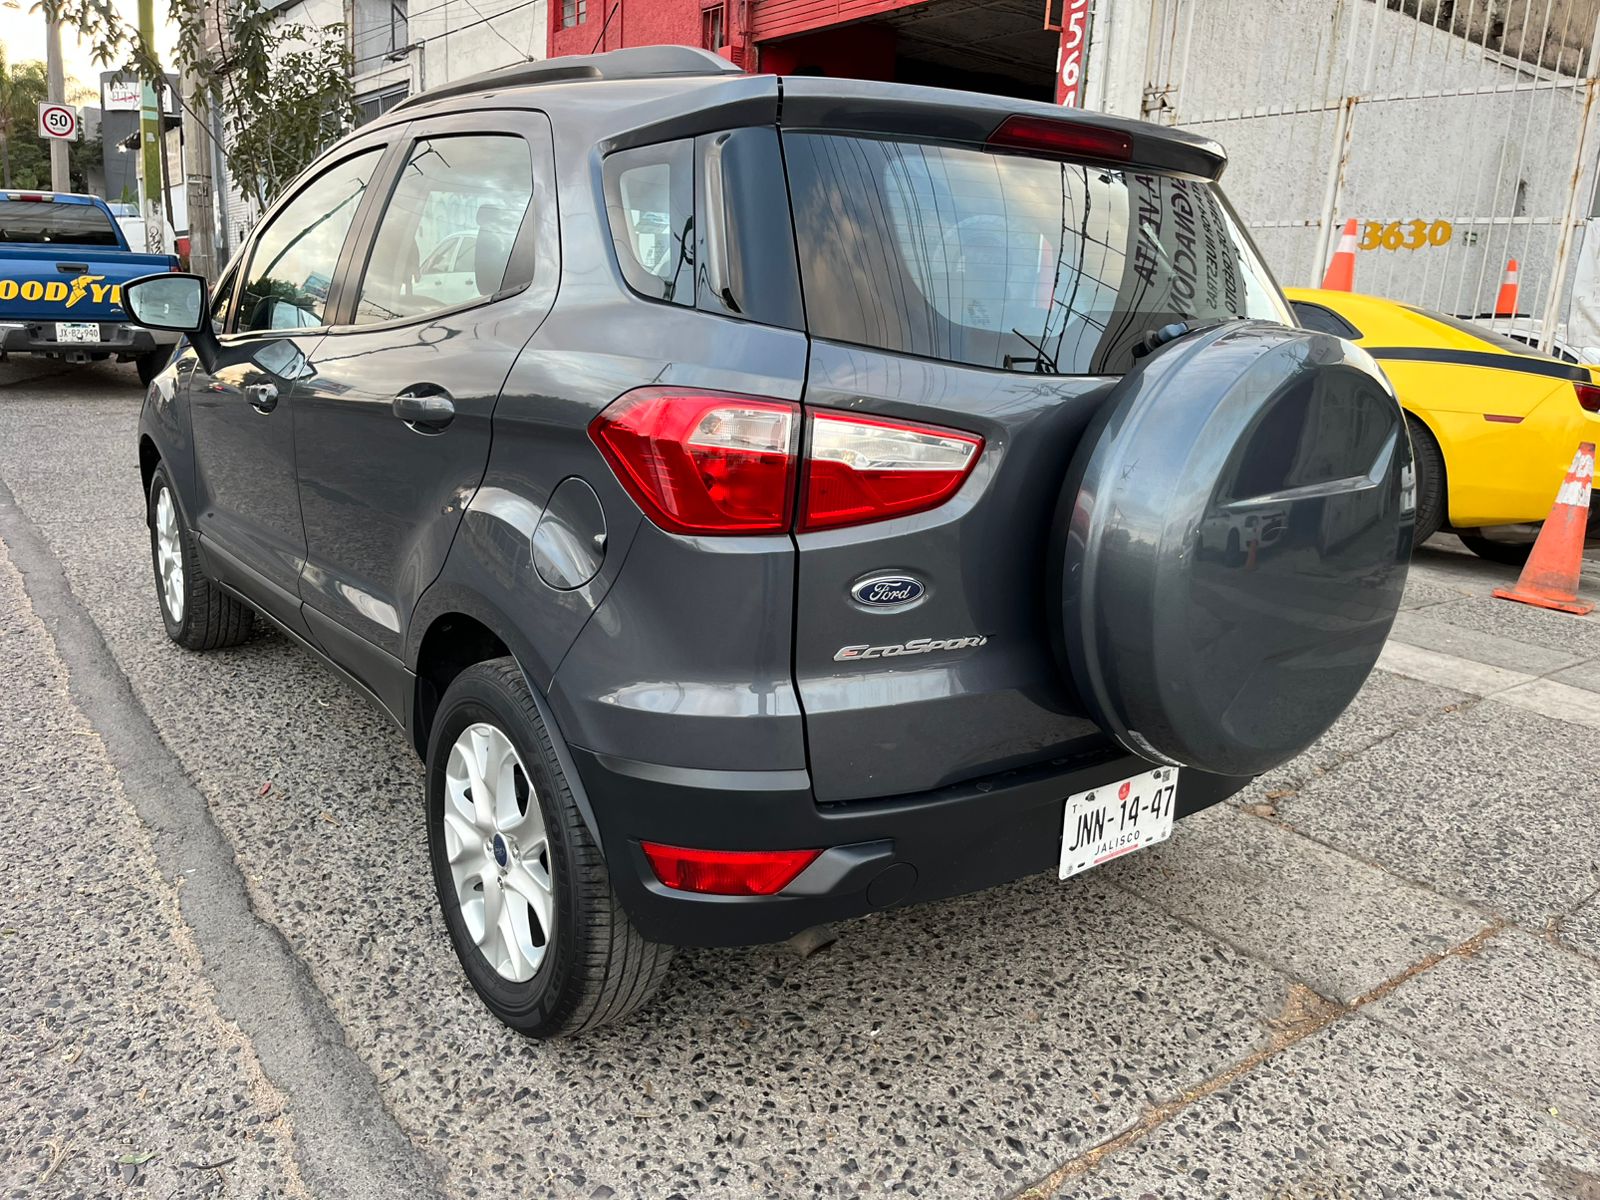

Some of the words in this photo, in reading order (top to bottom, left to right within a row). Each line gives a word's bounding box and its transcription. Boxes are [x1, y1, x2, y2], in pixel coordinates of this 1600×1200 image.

[50, 113, 67, 127] 50
[1357, 219, 1452, 250] 3630
[869, 581, 910, 601] Ford
[1069, 785, 1174, 851] JNN-14-47
[1094, 830, 1140, 856] JALISCO
